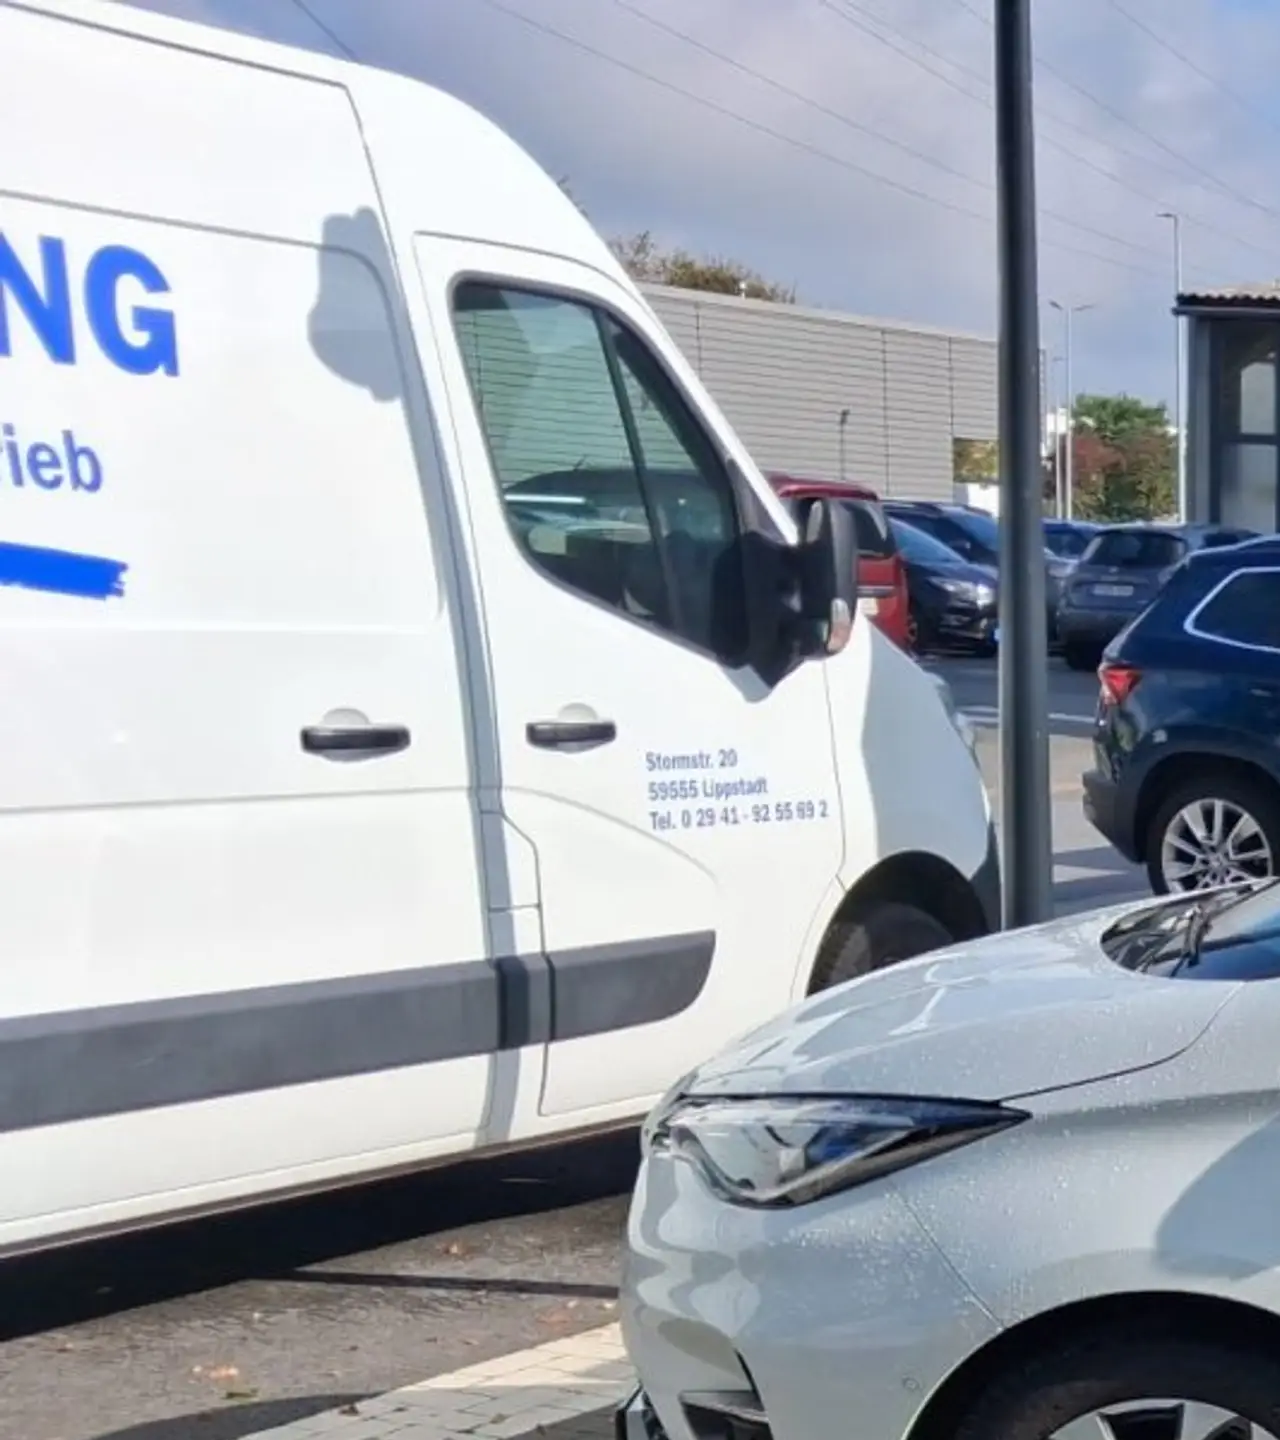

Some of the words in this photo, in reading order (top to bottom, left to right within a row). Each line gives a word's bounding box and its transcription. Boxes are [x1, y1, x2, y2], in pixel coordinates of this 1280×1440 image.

[718, 748, 738, 768] 20
[701, 777, 768, 801] Lippstadt
[649, 809, 677, 831] Tel.
[681, 808, 692, 830] 0
[696, 807, 716, 828] 29
[720, 805, 739, 825] 41
[751, 803, 770, 823] 92
[775, 801, 793, 822] 55
[818, 798, 829, 819] 2
